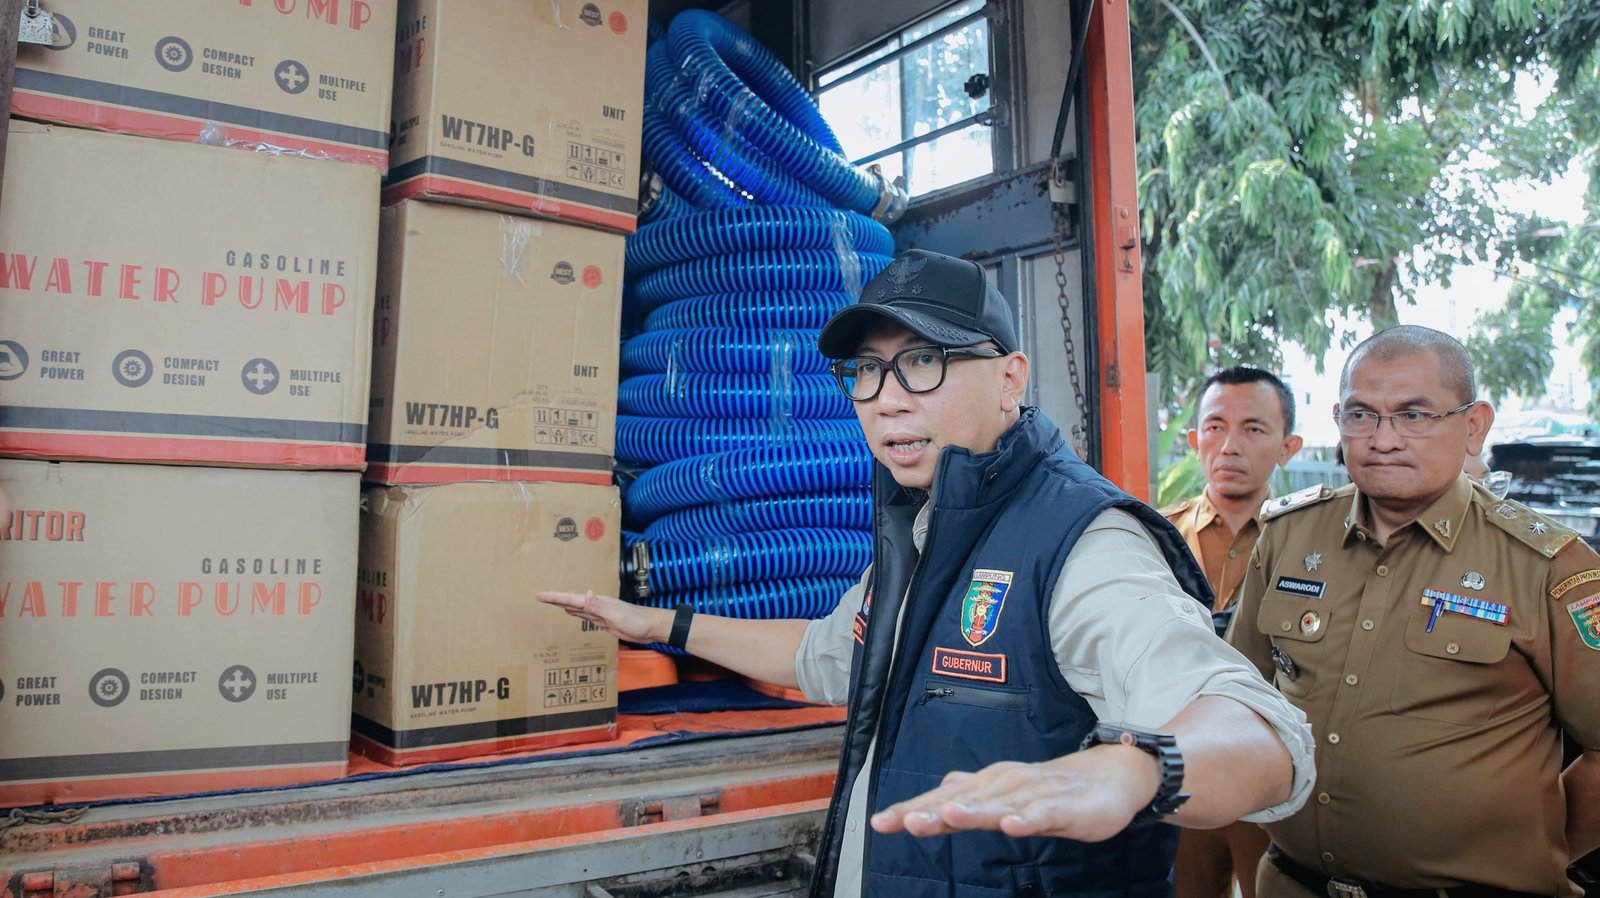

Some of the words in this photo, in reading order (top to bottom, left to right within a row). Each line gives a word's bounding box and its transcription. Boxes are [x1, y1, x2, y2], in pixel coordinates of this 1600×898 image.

[88, 26, 126, 43] GREAT
[87, 41, 129, 59] POWER
[203, 47, 256, 67] COMPACT
[202, 62, 242, 79] DESIGN
[319, 73, 367, 93] MULTIPLE
[318, 89, 338, 101] USE
[602, 105, 626, 121] UNIT
[442, 114, 536, 158] WT7HP-G
[226, 250, 346, 277] GASOLINE
[0, 253, 181, 303] WATER
[201, 271, 346, 316] PUMP
[41, 350, 81, 364] GREAT
[164, 357, 220, 372] COMPACT
[40, 366, 85, 381] POWER
[290, 369, 342, 384] MULTIPLE
[573, 364, 599, 378] UNIT
[163, 373, 206, 387] DESIGN
[289, 384, 311, 397] USE
[405, 402, 499, 429] WT7HP-G
[201, 557, 322, 575] GASOLINE
[1278, 579, 1320, 594] ASWARODI
[177, 581, 322, 617] PUMP
[942, 655, 992, 674] GUBERNUR
[17, 676, 57, 690] GREAT
[140, 671, 197, 685] COMPACT
[267, 672, 319, 685] MULTIPLE
[16, 693, 60, 707] POWER
[140, 687, 183, 701] DESIGN
[266, 687, 287, 700] USE
[411, 677, 510, 709] WT7HP-G
